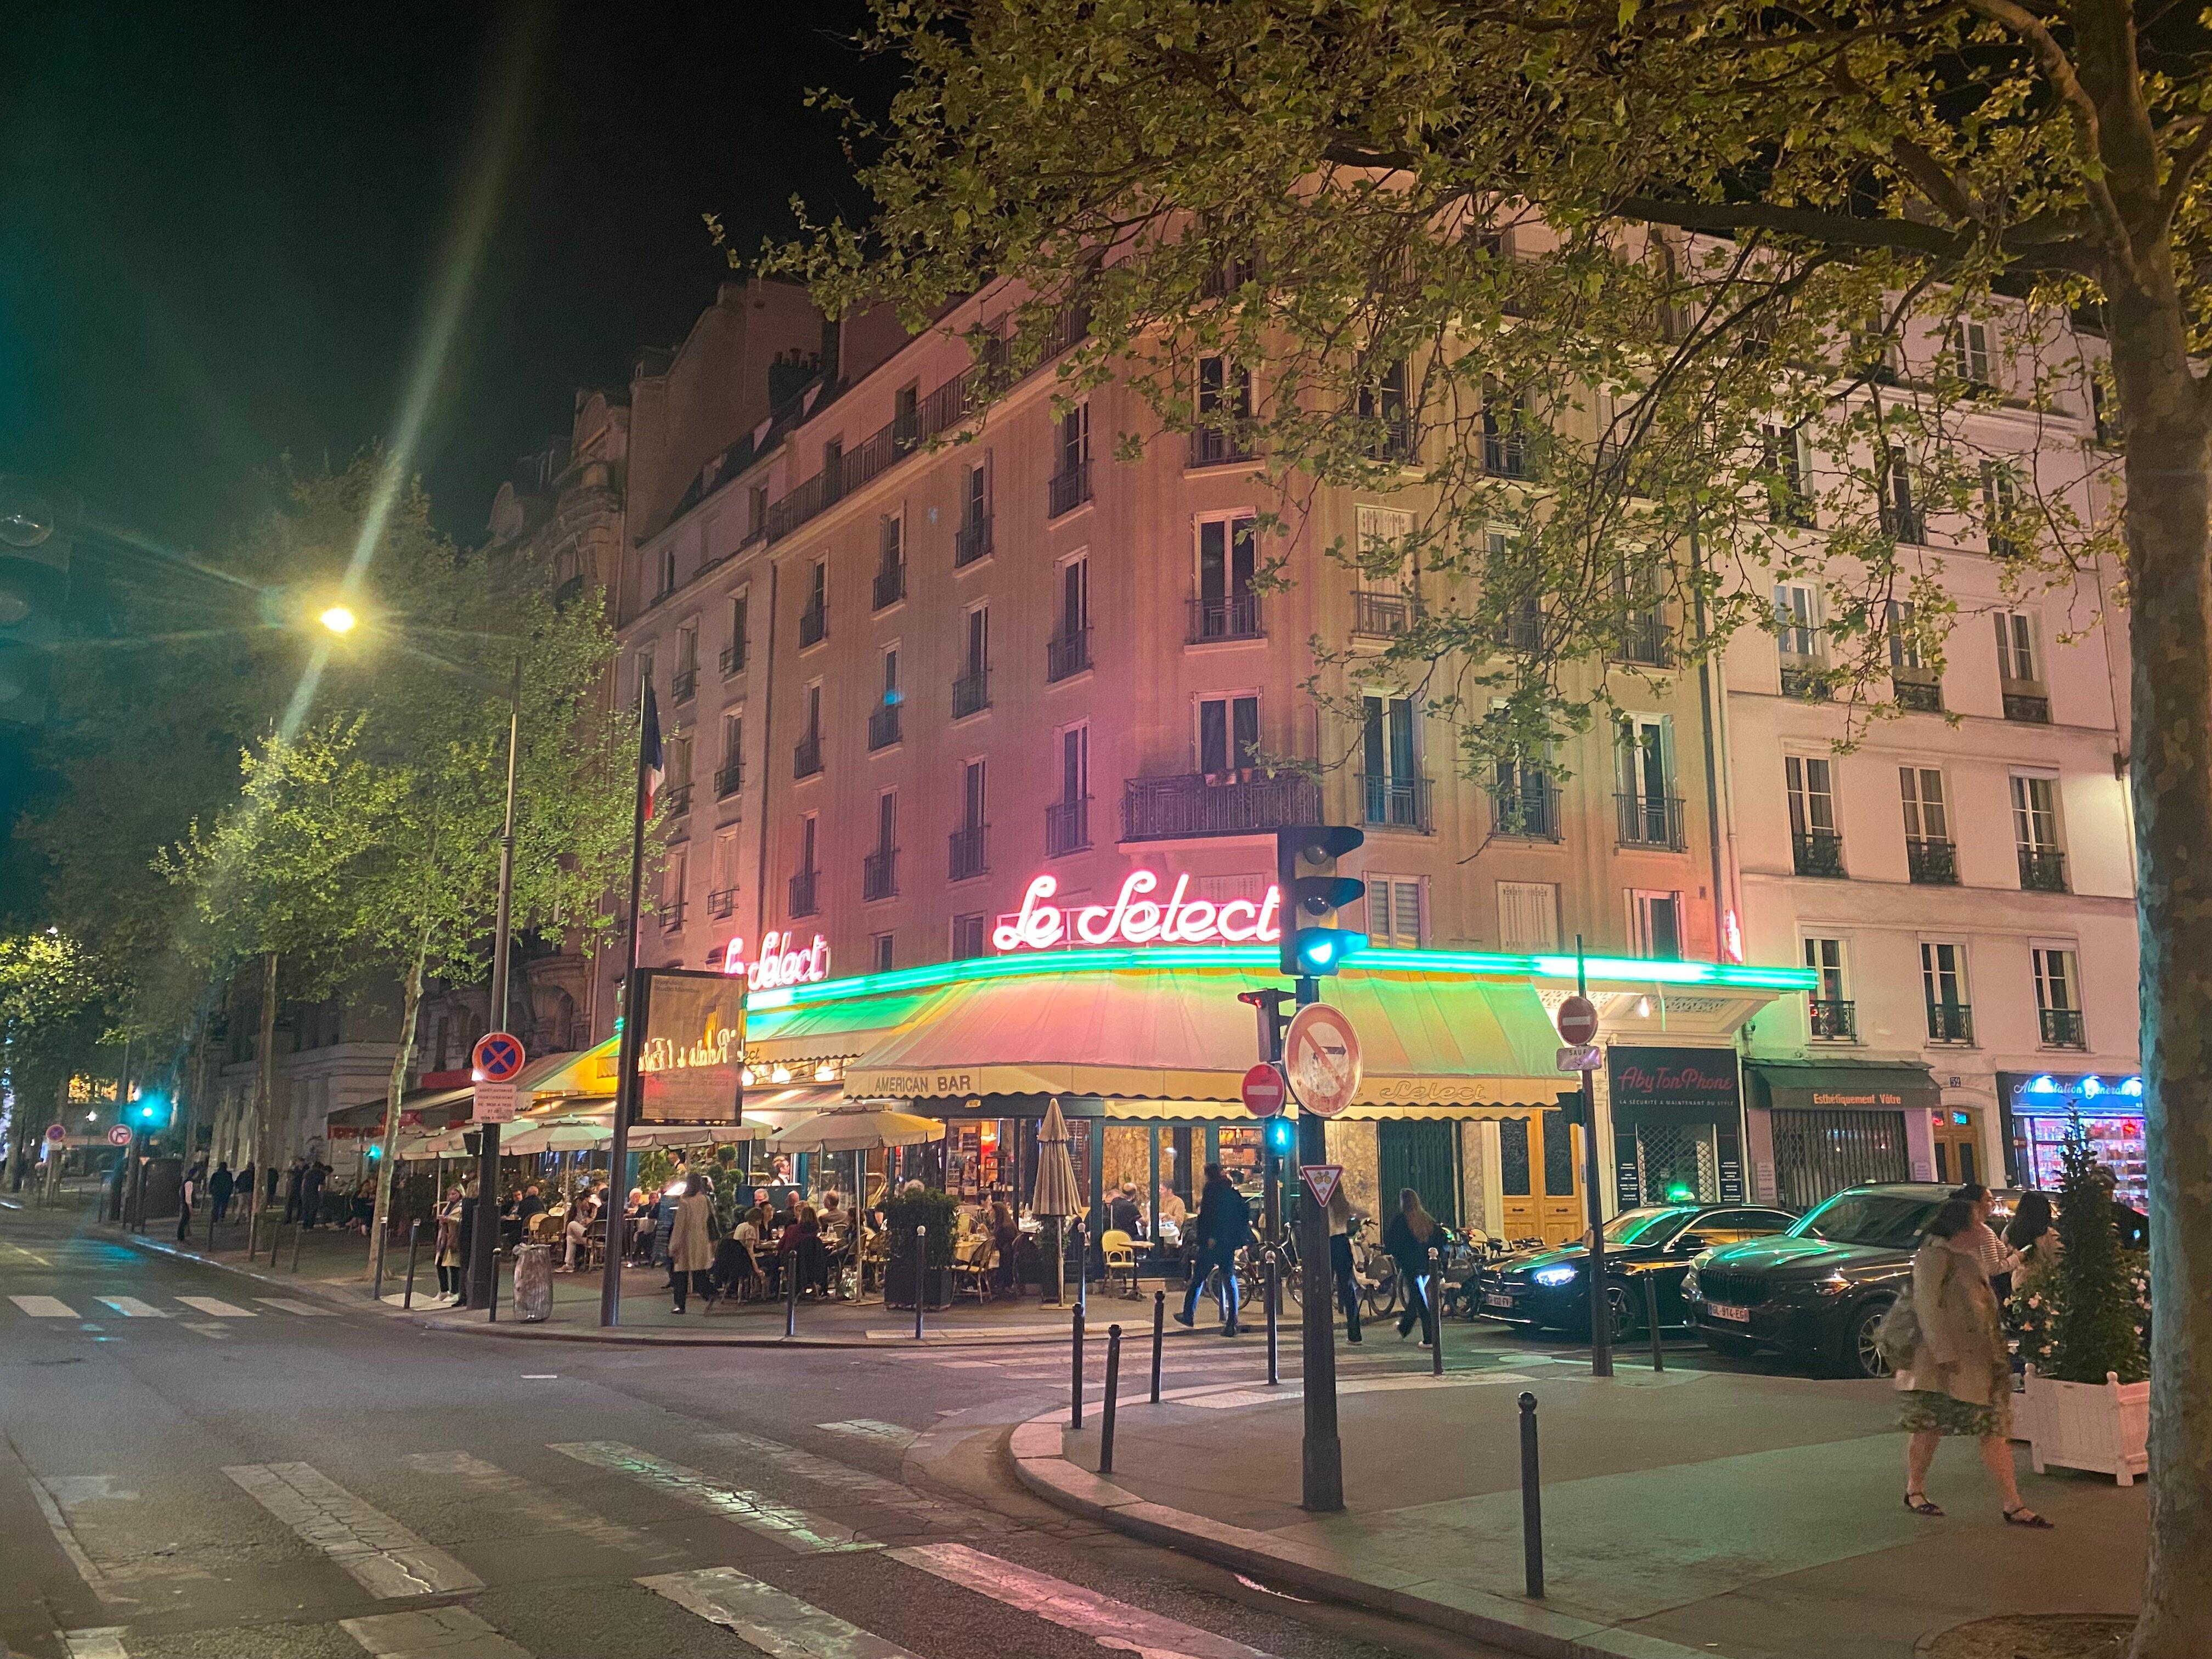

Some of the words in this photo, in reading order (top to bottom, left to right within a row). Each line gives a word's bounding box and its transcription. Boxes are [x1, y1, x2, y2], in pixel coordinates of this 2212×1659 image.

[992, 874, 1064, 950] Le
[1077, 870, 1280, 944] Select
[747, 930, 827, 991] Select
[875, 1076, 928, 1092] AMERICAN
[937, 1075, 971, 1092] BAR
[1379, 1080, 1486, 1100] Select
[1951, 1077, 1960, 1087] 52
[1813, 1093, 1875, 1106] Esthétiquement
